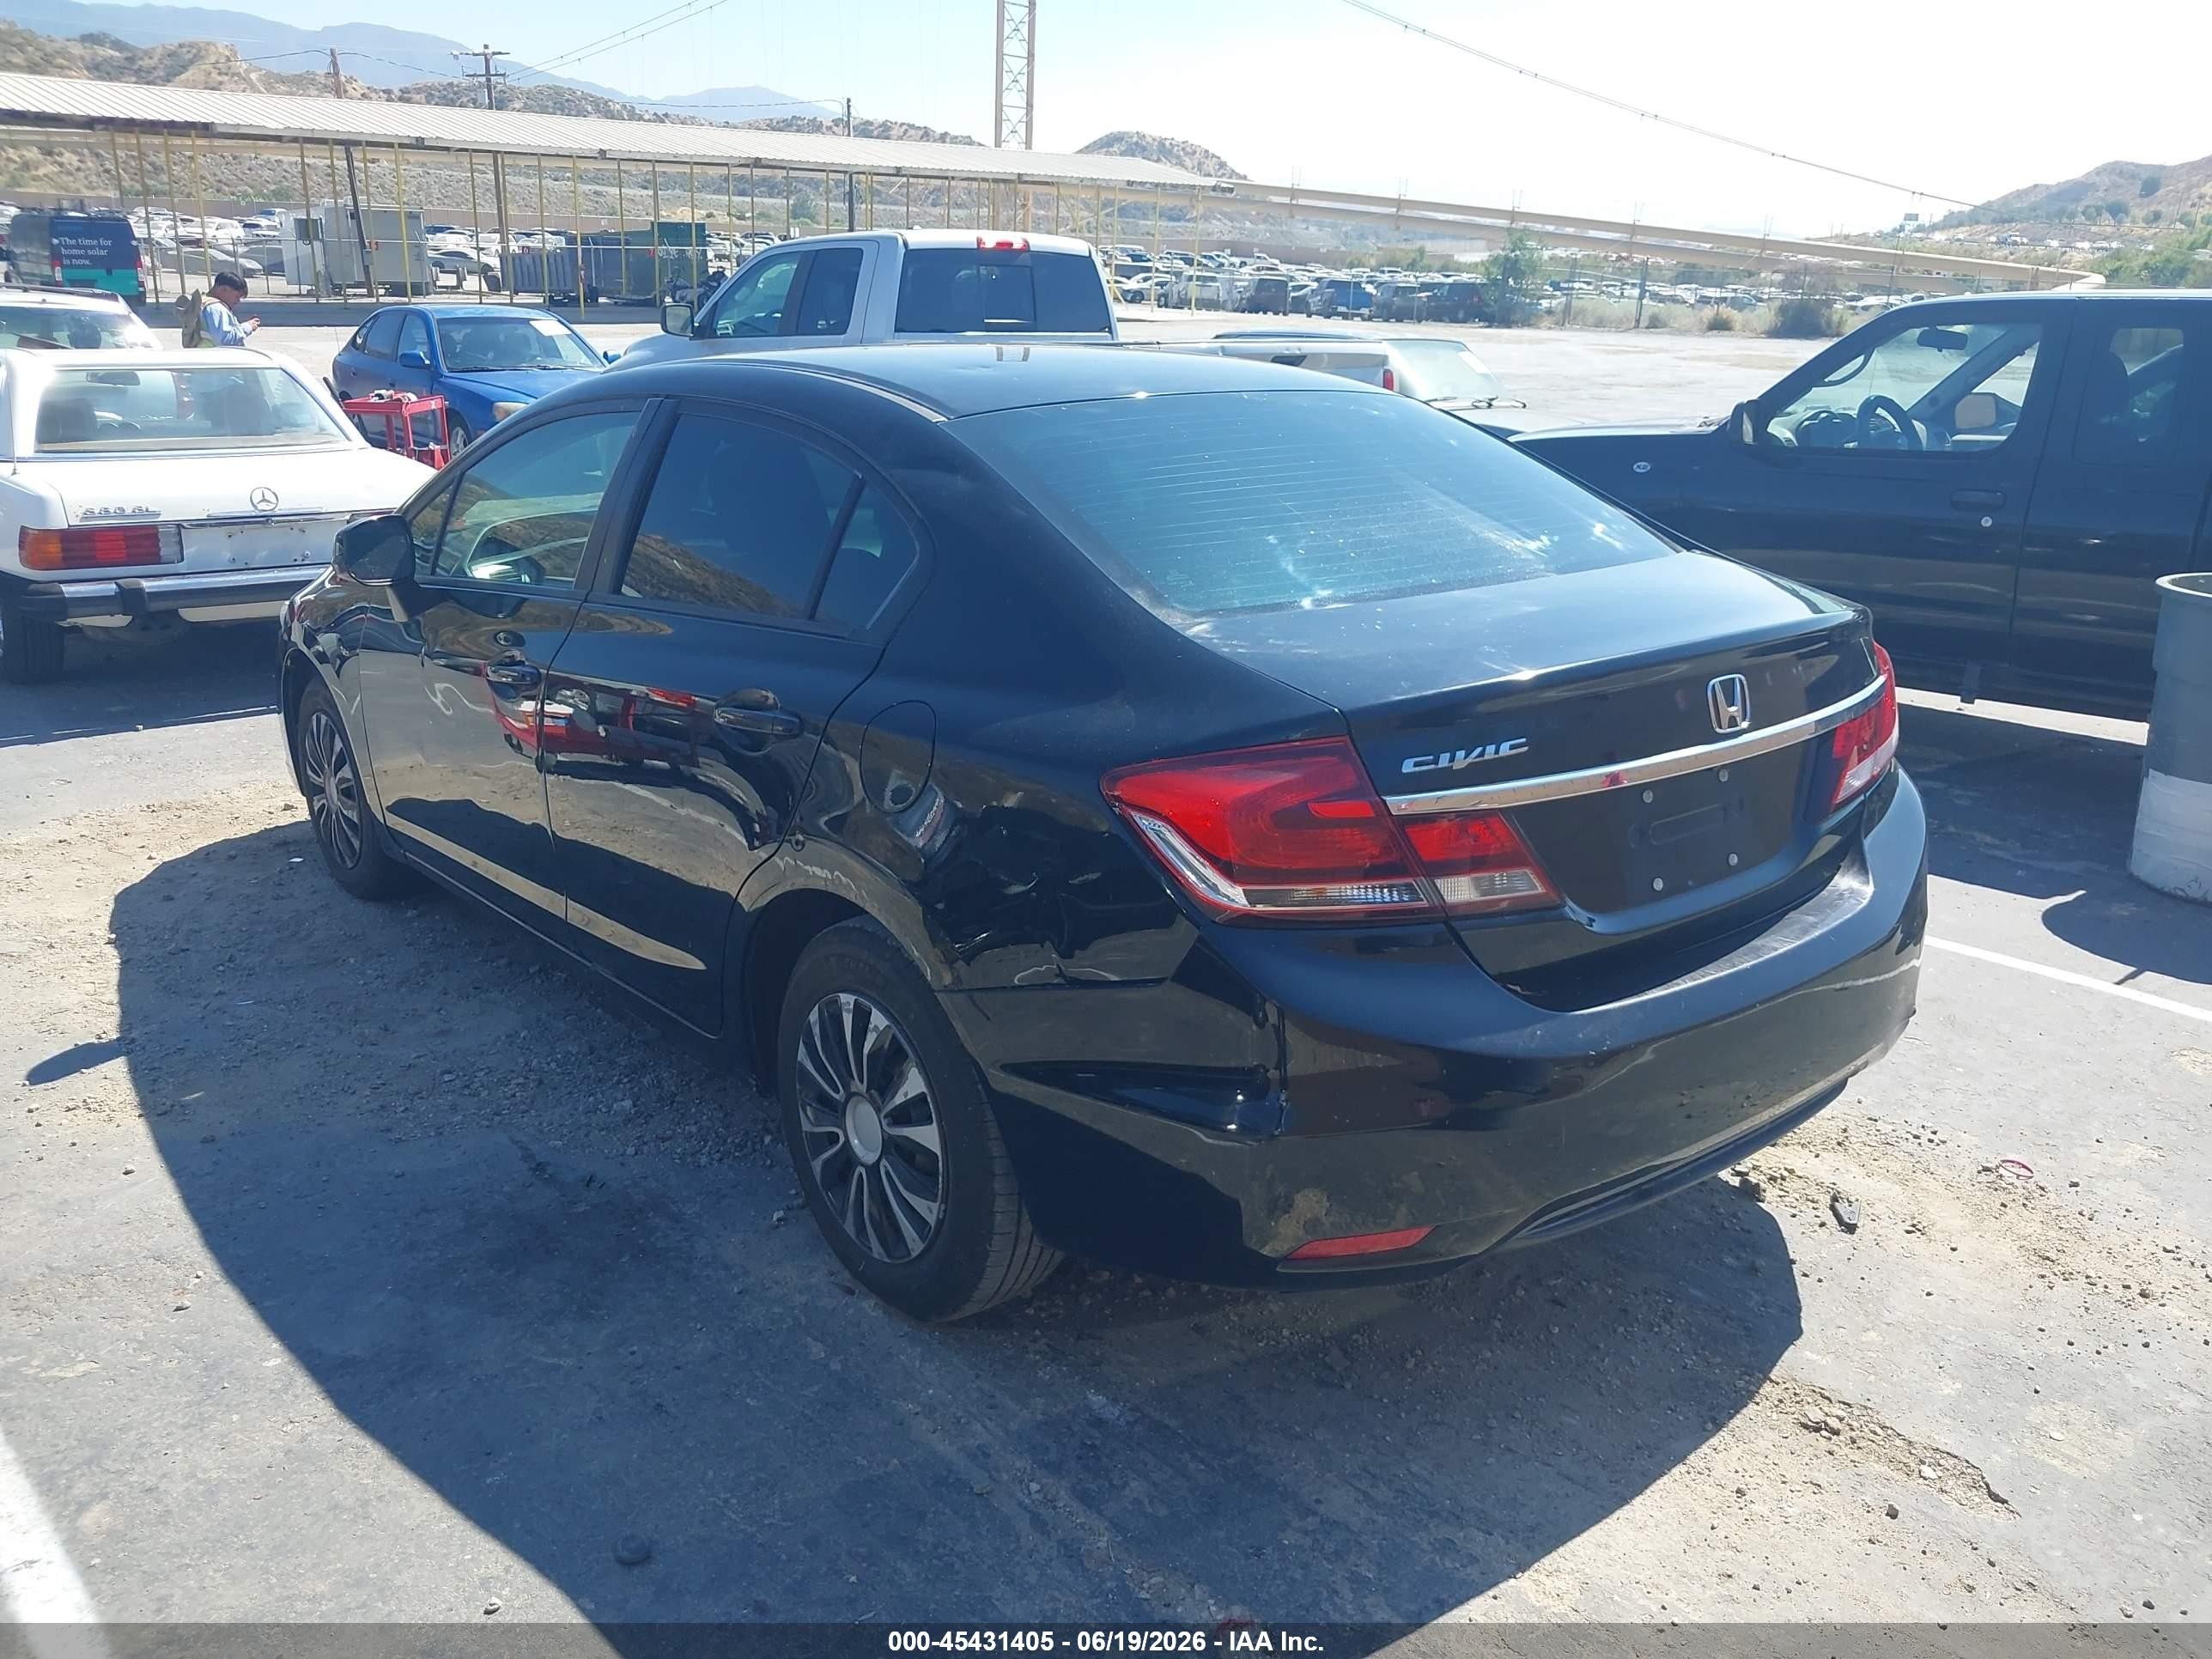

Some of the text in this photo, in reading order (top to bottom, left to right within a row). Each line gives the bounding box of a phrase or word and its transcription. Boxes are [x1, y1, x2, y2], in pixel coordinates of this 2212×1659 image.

[59, 237, 112, 246] The time for
[61, 247, 108, 256] home solar
[1401, 737, 1529, 773] CIVIC
